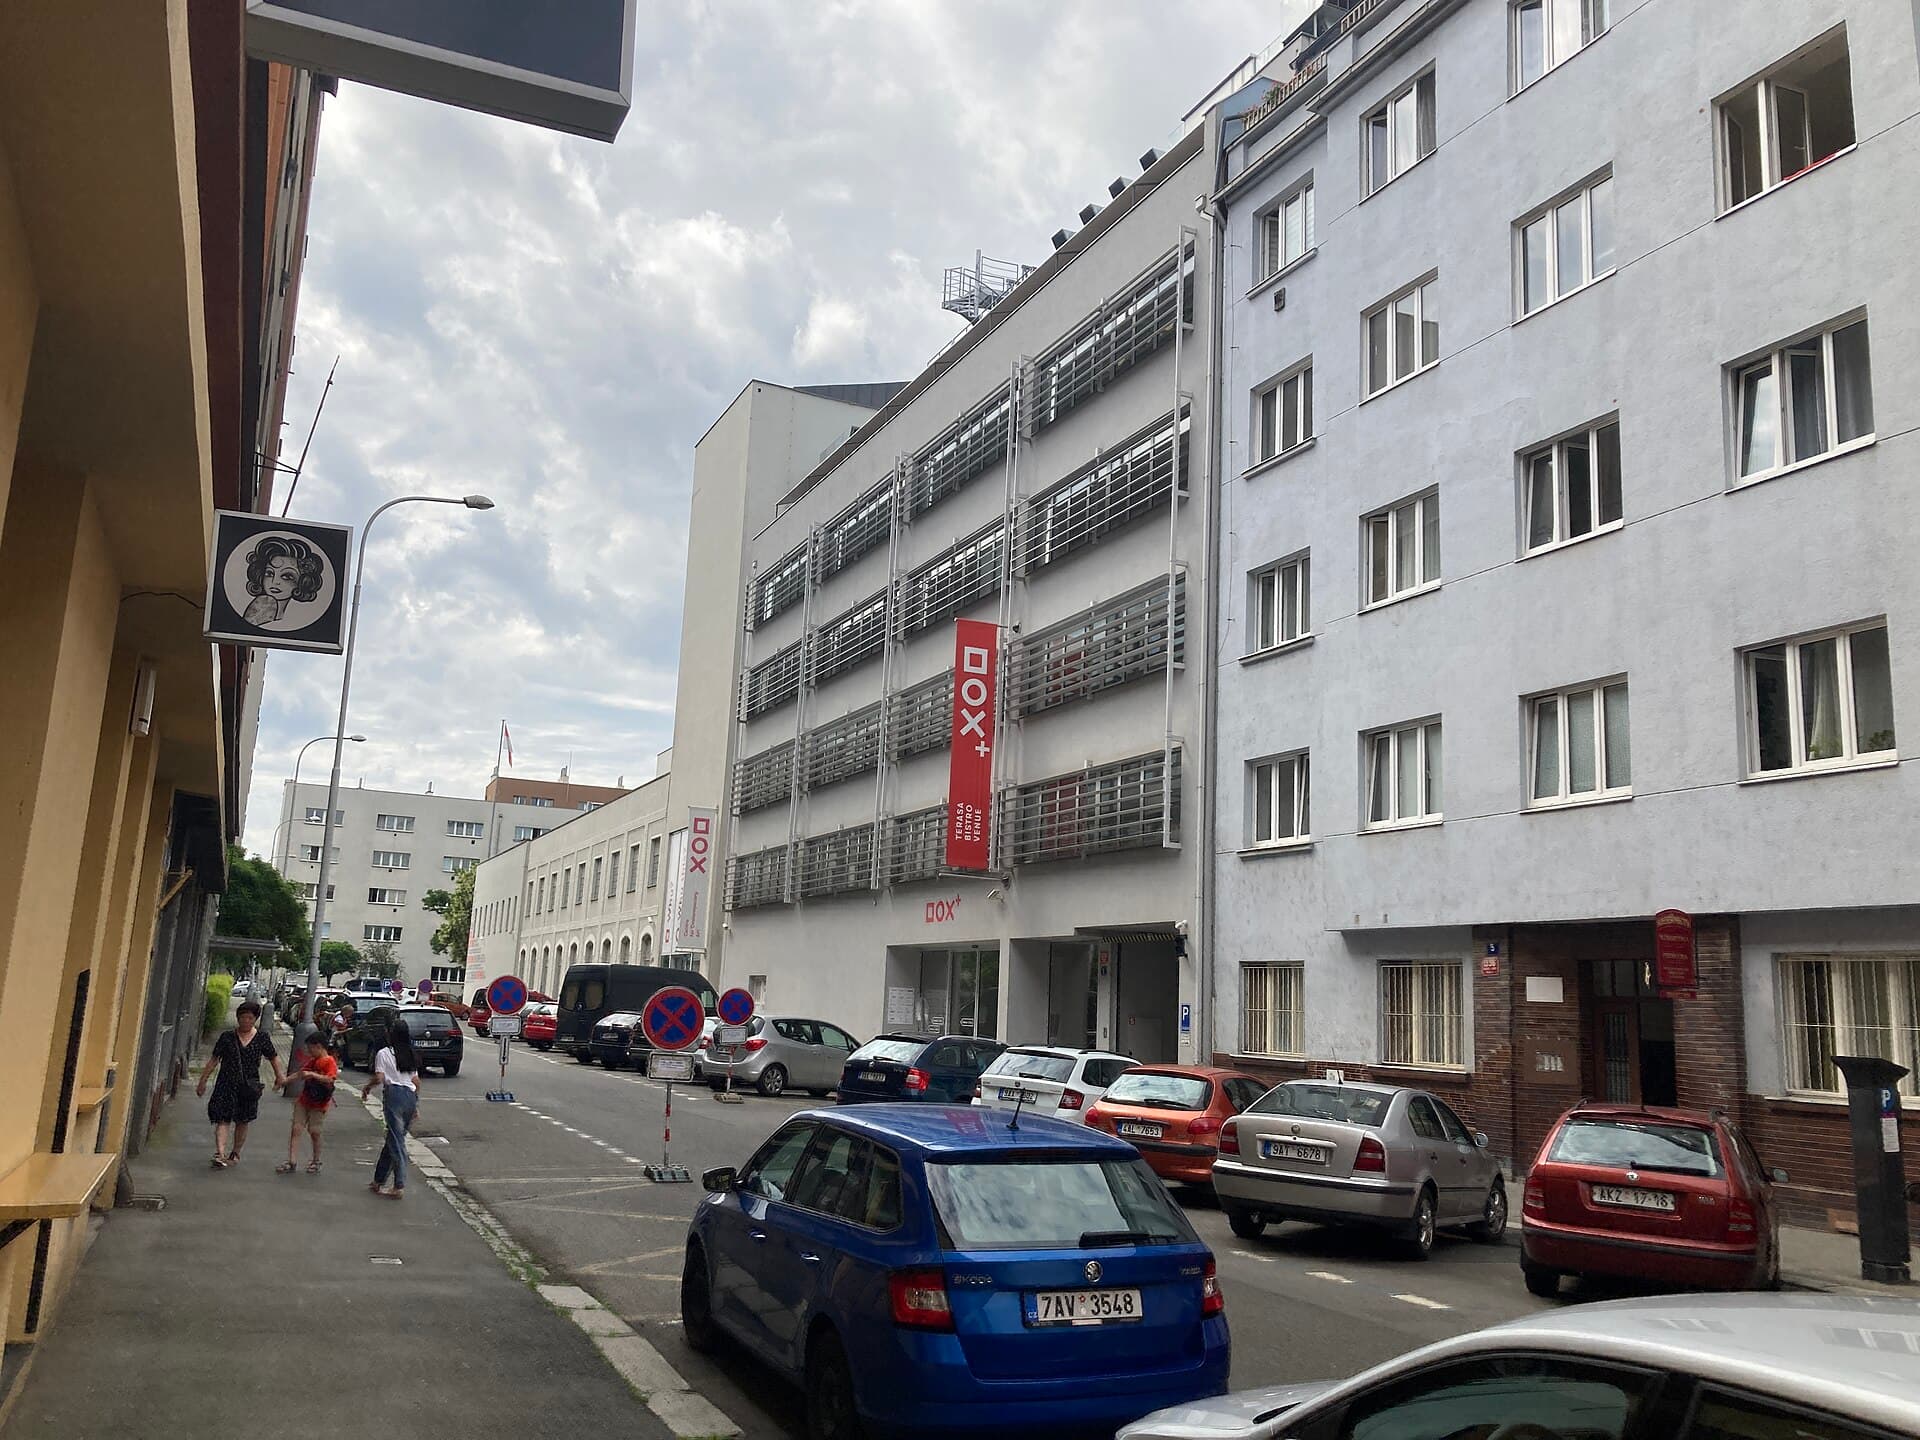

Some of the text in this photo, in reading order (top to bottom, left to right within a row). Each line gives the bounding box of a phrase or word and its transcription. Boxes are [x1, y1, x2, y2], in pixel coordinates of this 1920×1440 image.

[955, 802, 964, 840] TERASA
[964, 804, 973, 841] BISTRO
[973, 808, 982, 842] VENUE
[1182, 1006, 1189, 1020] P
[1881, 1089, 1891, 1108] P
[1297, 1145, 1321, 1159] 6678
[1600, 1187, 1622, 1203] AKZ
[1028, 1311, 1038, 1319] CZ
[1042, 1293, 1134, 1318] 7AV 3548
